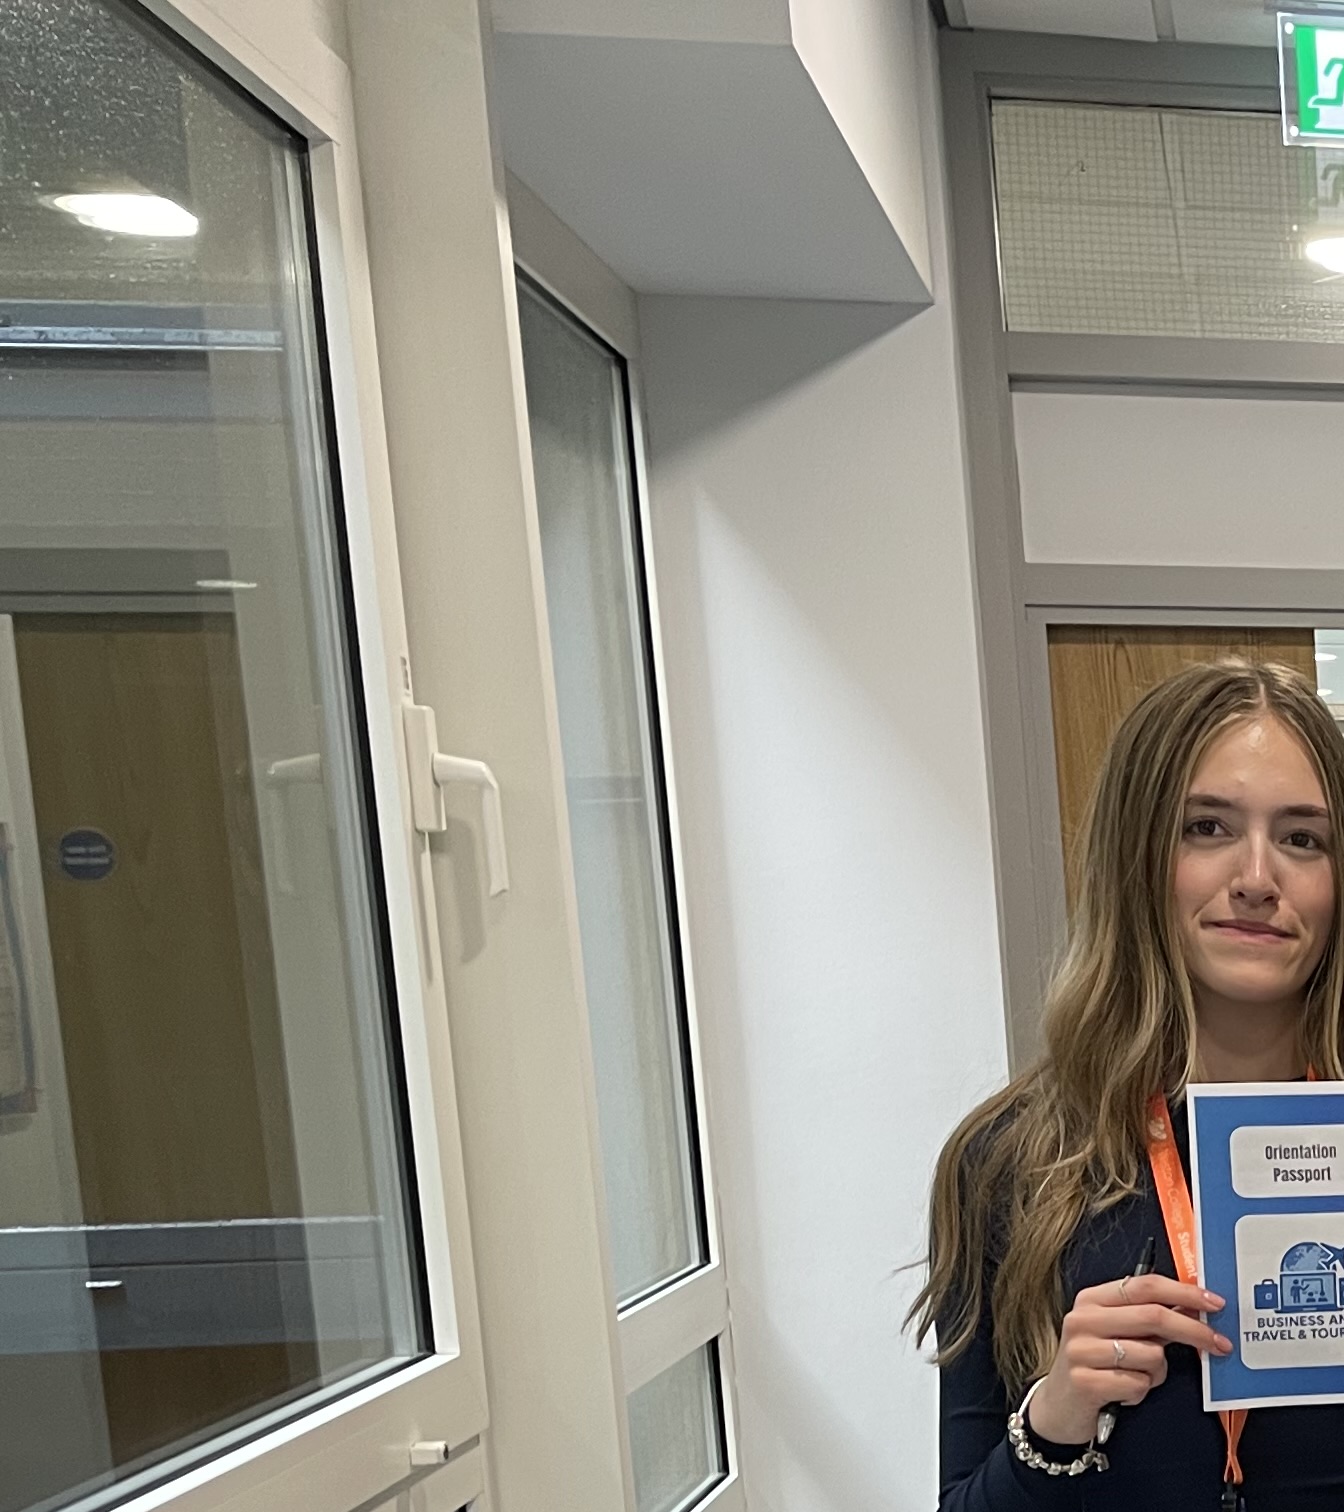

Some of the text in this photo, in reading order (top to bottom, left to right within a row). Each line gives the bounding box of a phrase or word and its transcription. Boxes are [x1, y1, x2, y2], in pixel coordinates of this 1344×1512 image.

[1265, 1144, 1337, 1160] Orientation
[1273, 1166, 1331, 1183] Passport
[1177, 1231, 1198, 1278] Student
[1257, 1314, 1325, 1328] BUSINESS
[1244, 1329, 1296, 1342] TRAVEL
[1298, 1329, 1307, 1339] &
